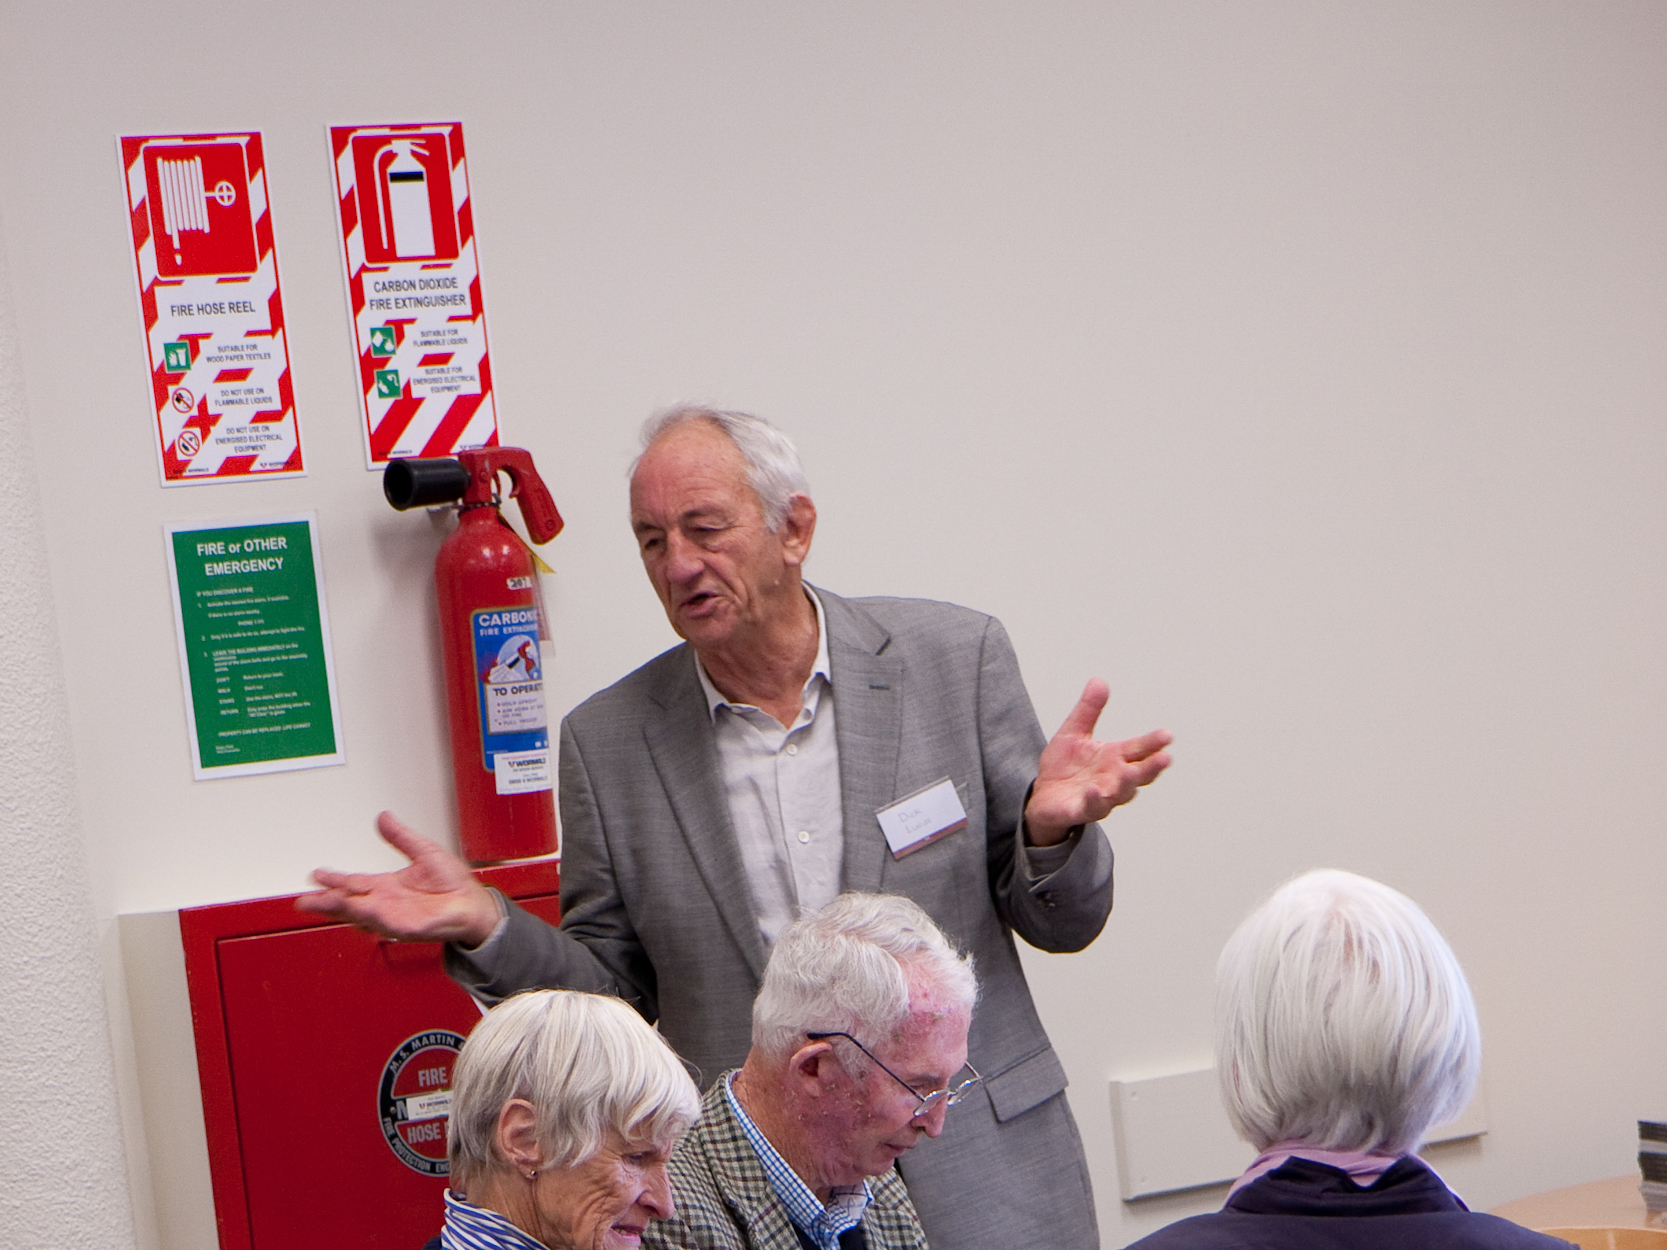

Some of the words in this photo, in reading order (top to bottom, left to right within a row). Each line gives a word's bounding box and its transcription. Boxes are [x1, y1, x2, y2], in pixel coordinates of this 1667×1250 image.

[374, 280, 416, 292] CARBON
[418, 278, 458, 290] DIOXIDE
[370, 299, 392, 310] FIRE
[395, 294, 466, 309] EXTINGUISHER
[171, 304, 194, 317] FIRE
[197, 303, 226, 316] HOSE
[229, 301, 256, 313] REEL
[420, 330, 446, 338] SUITABLE
[217, 345, 245, 354] SUITABLE
[246, 344, 258, 352] FOR
[206, 355, 224, 363] WOOD
[226, 354, 244, 362] PAPER
[246, 352, 271, 360] TEXTILES
[424, 368, 450, 376] SUITABLE
[231, 388, 243, 396] NOT
[244, 388, 255, 396] USE
[256, 388, 264, 396] ON
[215, 398, 250, 407] FLAMMABLE
[249, 426, 260, 434] USE
[215, 436, 248, 445] ENERGISED
[248, 434, 283, 443] ELECTRICAL
[234, 444, 267, 454] EQUIPMENT
[196, 542, 226, 556] FIRE
[228, 543, 242, 554] or
[244, 537, 288, 552] OTHER
[204, 557, 284, 576] EMERGENCY
[480, 627, 500, 637] FIRE
[493, 687, 508, 696] TO
[411, 1034, 455, 1051] MARTIN
[418, 1066, 448, 1087] FIRE
[407, 1122, 441, 1144] HOSE
